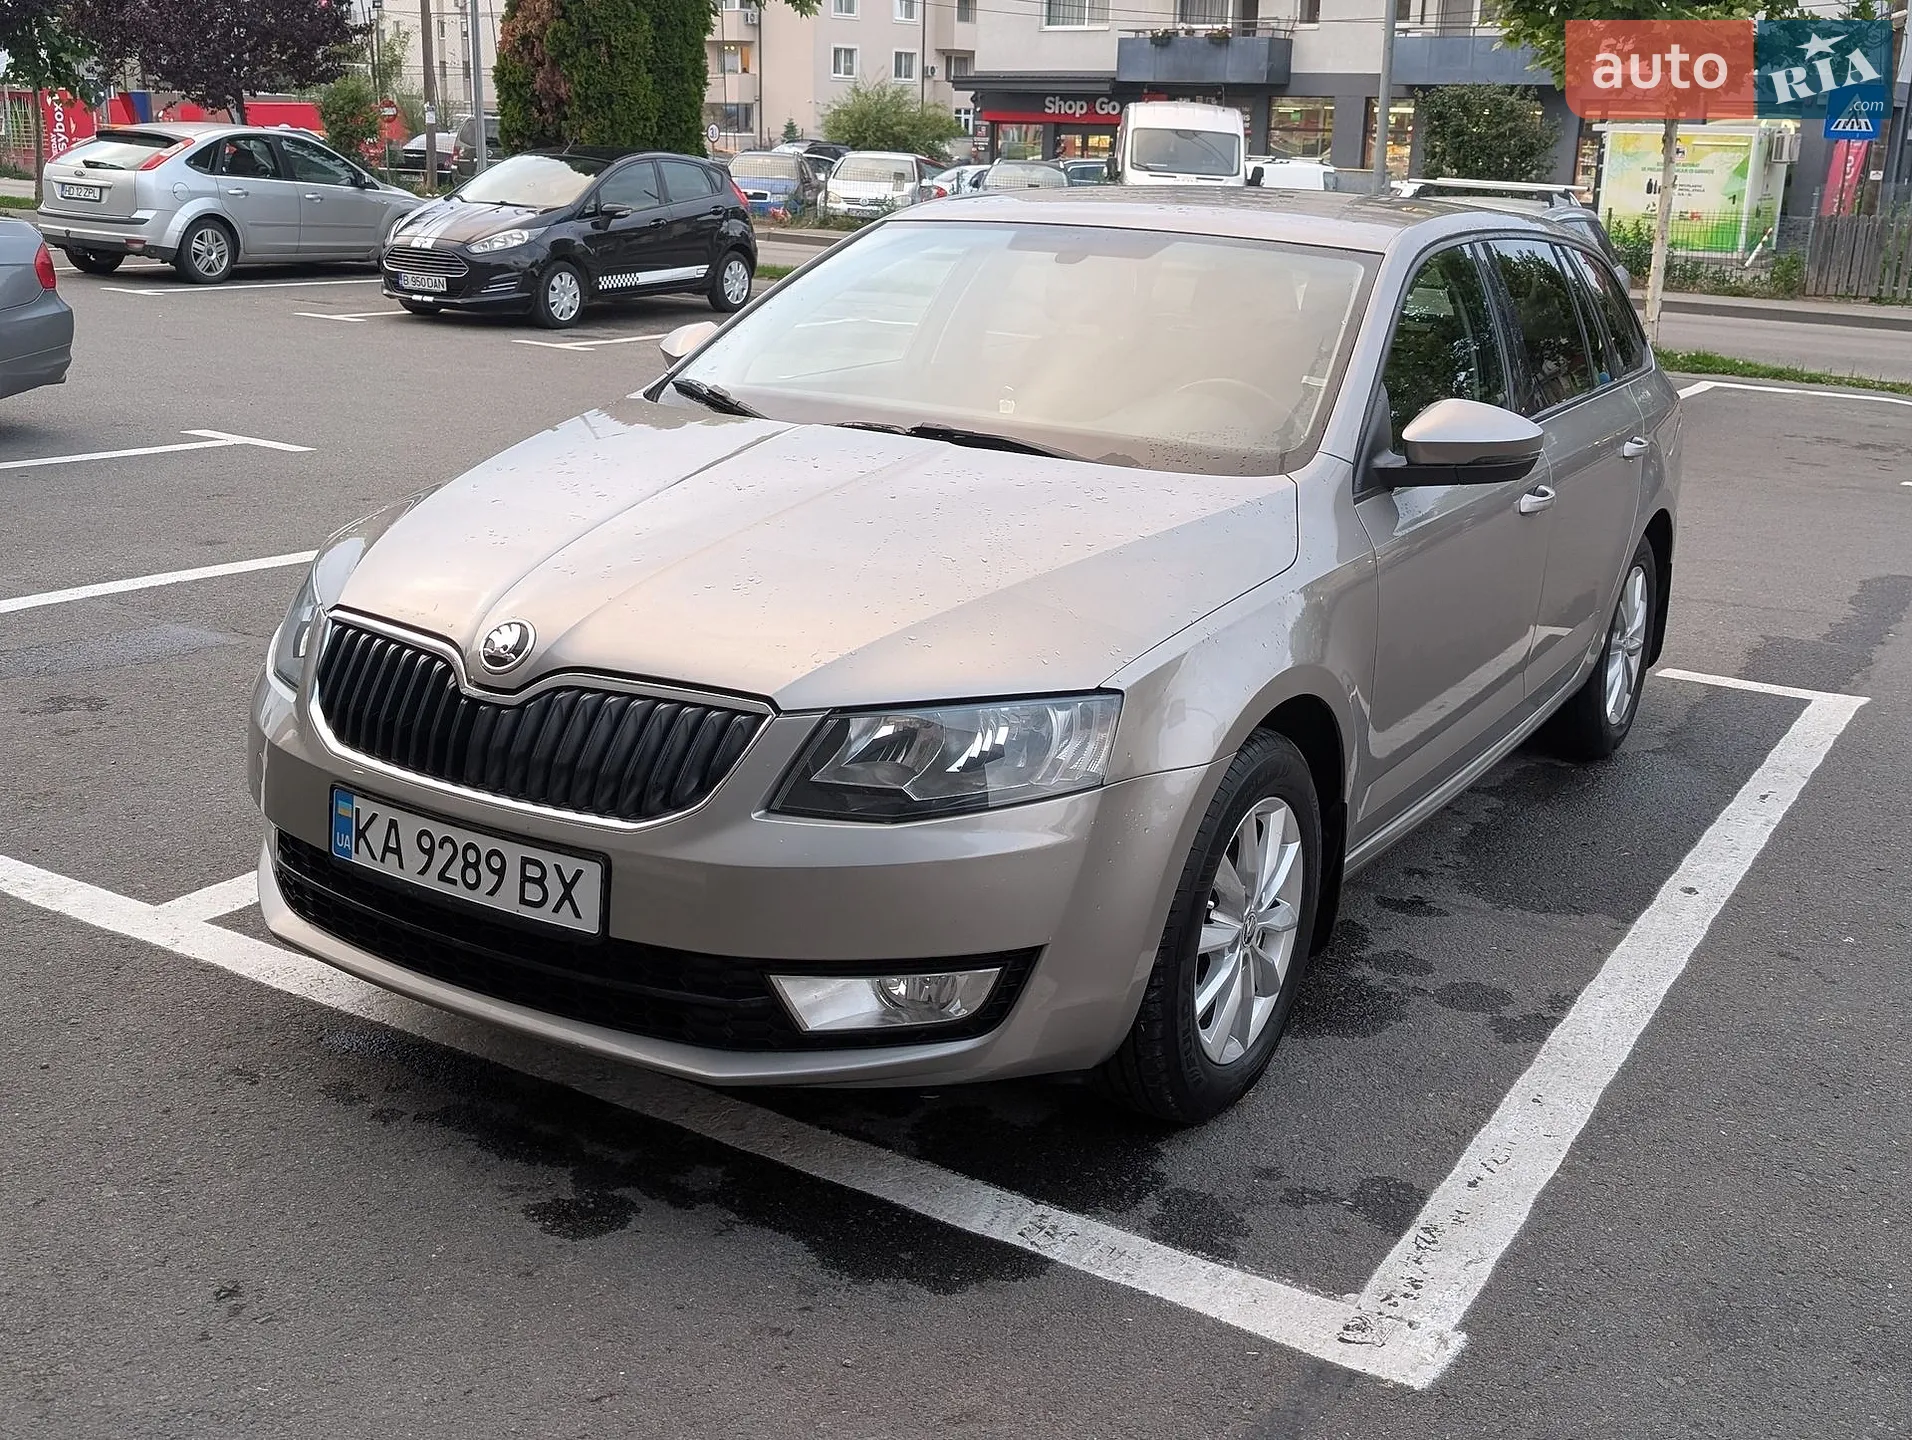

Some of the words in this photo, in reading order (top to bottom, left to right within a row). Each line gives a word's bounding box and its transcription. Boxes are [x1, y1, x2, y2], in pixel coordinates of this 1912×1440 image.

[1044, 96, 1088, 118] Shop
[1095, 97, 1120, 115] Go
[53, 101, 69, 151] sybox
[403, 275, 409, 286] B
[427, 277, 445, 290] DAN
[336, 831, 351, 850] UA
[355, 806, 404, 870] KA
[416, 828, 507, 897] 9289
[519, 855, 584, 920] BX
